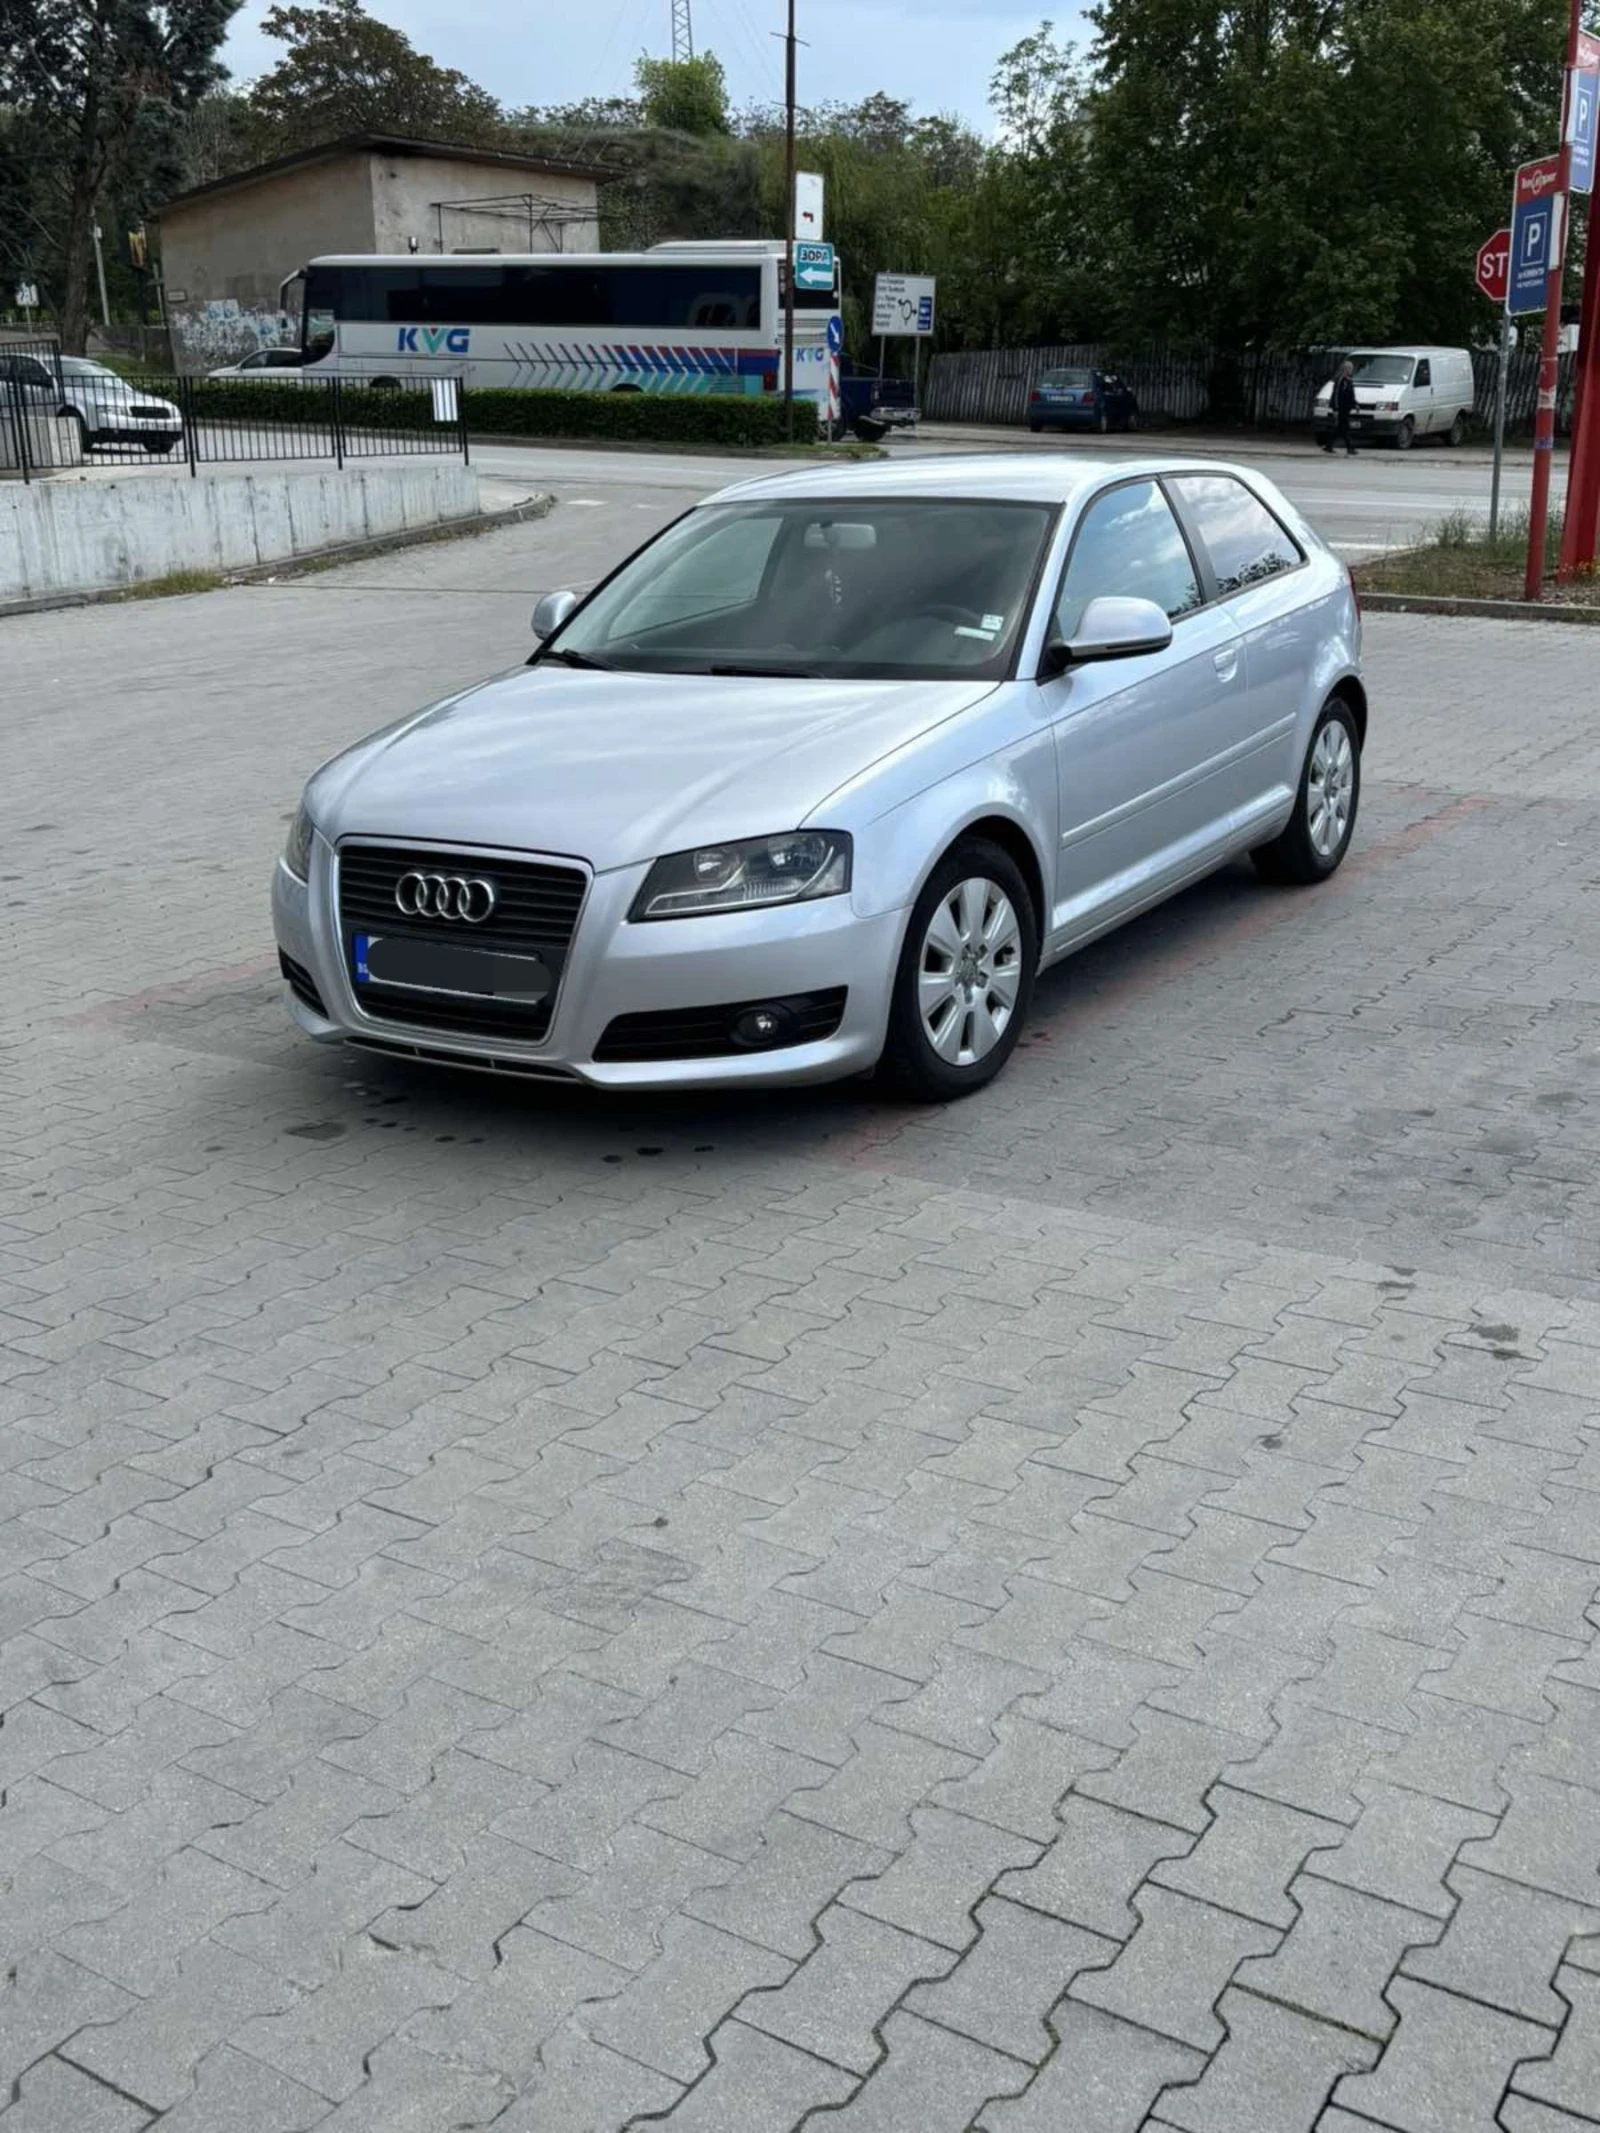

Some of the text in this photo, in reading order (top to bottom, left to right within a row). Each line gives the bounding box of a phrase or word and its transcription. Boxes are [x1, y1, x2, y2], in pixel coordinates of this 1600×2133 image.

[1527, 222, 1541, 257] P
[1481, 252, 1508, 279] ST
[398, 327, 470, 356] KVG
